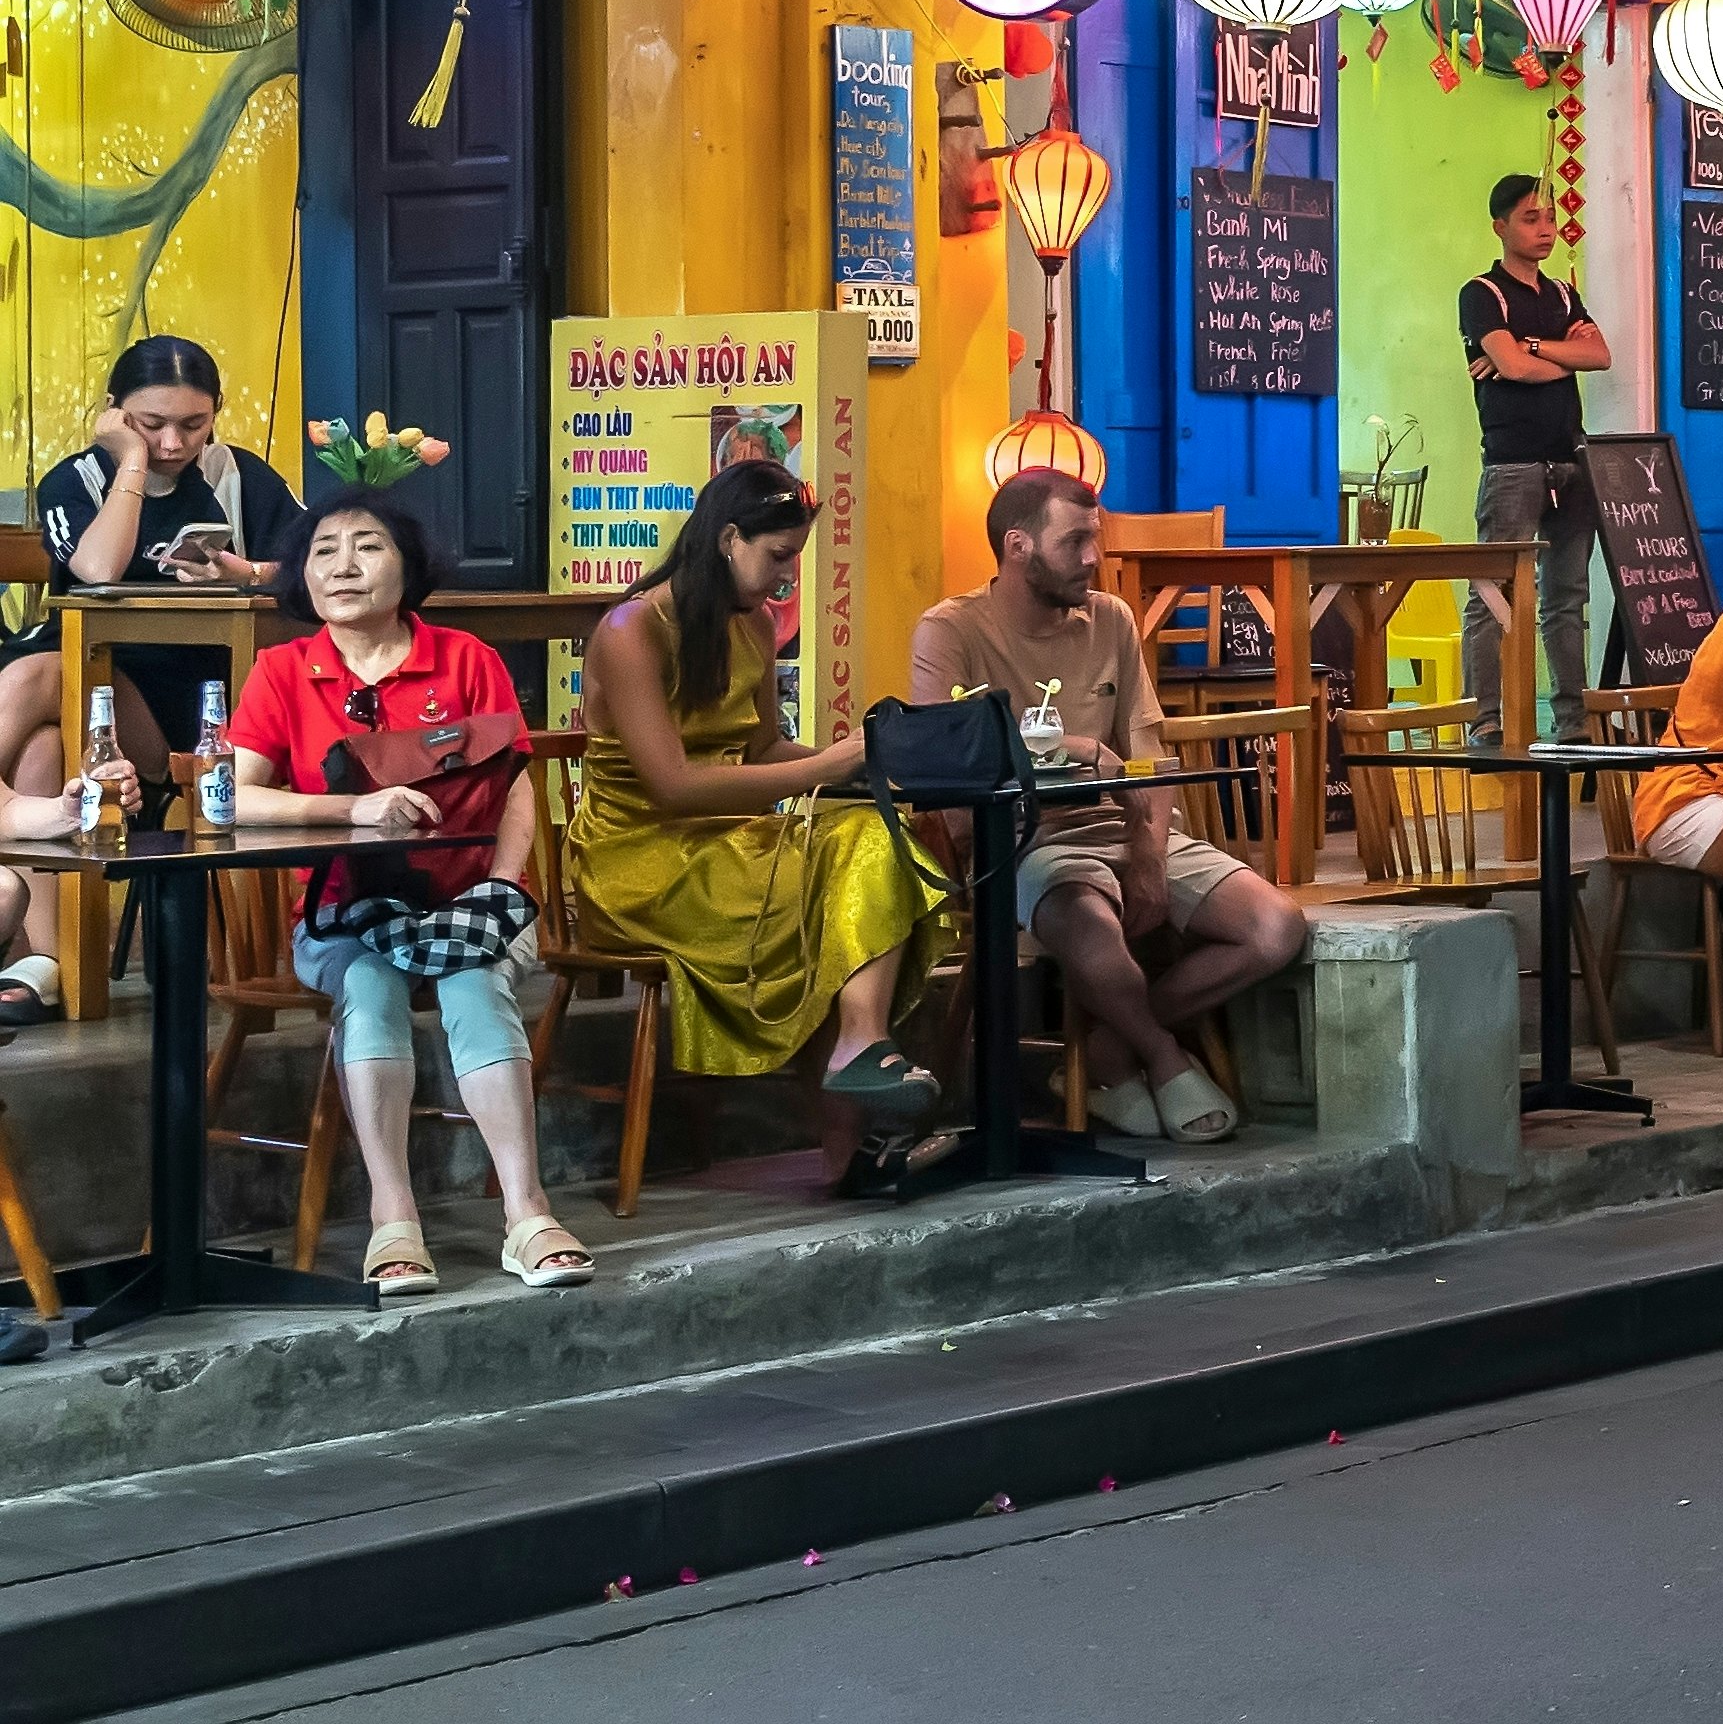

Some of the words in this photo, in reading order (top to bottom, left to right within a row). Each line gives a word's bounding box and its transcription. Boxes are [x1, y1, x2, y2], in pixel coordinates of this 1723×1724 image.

[1264, 216, 1288, 242] Mi
[853, 288, 905, 307] TAXI
[1209, 339, 1257, 362] French
[568, 336, 627, 400] ĐẶC
[632, 330, 689, 390] SẢN
[695, 333, 747, 397] HỘI
[753, 341, 797, 386] AN
[572, 412, 601, 437] CAO
[834, 395, 853, 459] AN
[606, 486, 639, 515] THỊT
[829, 472, 857, 548] HỘI
[1603, 501, 1659, 526] HAPPY
[572, 523, 604, 551] THỊT
[1636, 537, 1688, 557] HOURS
[571, 557, 591, 584] BÒ
[825, 561, 852, 648] SẢN
